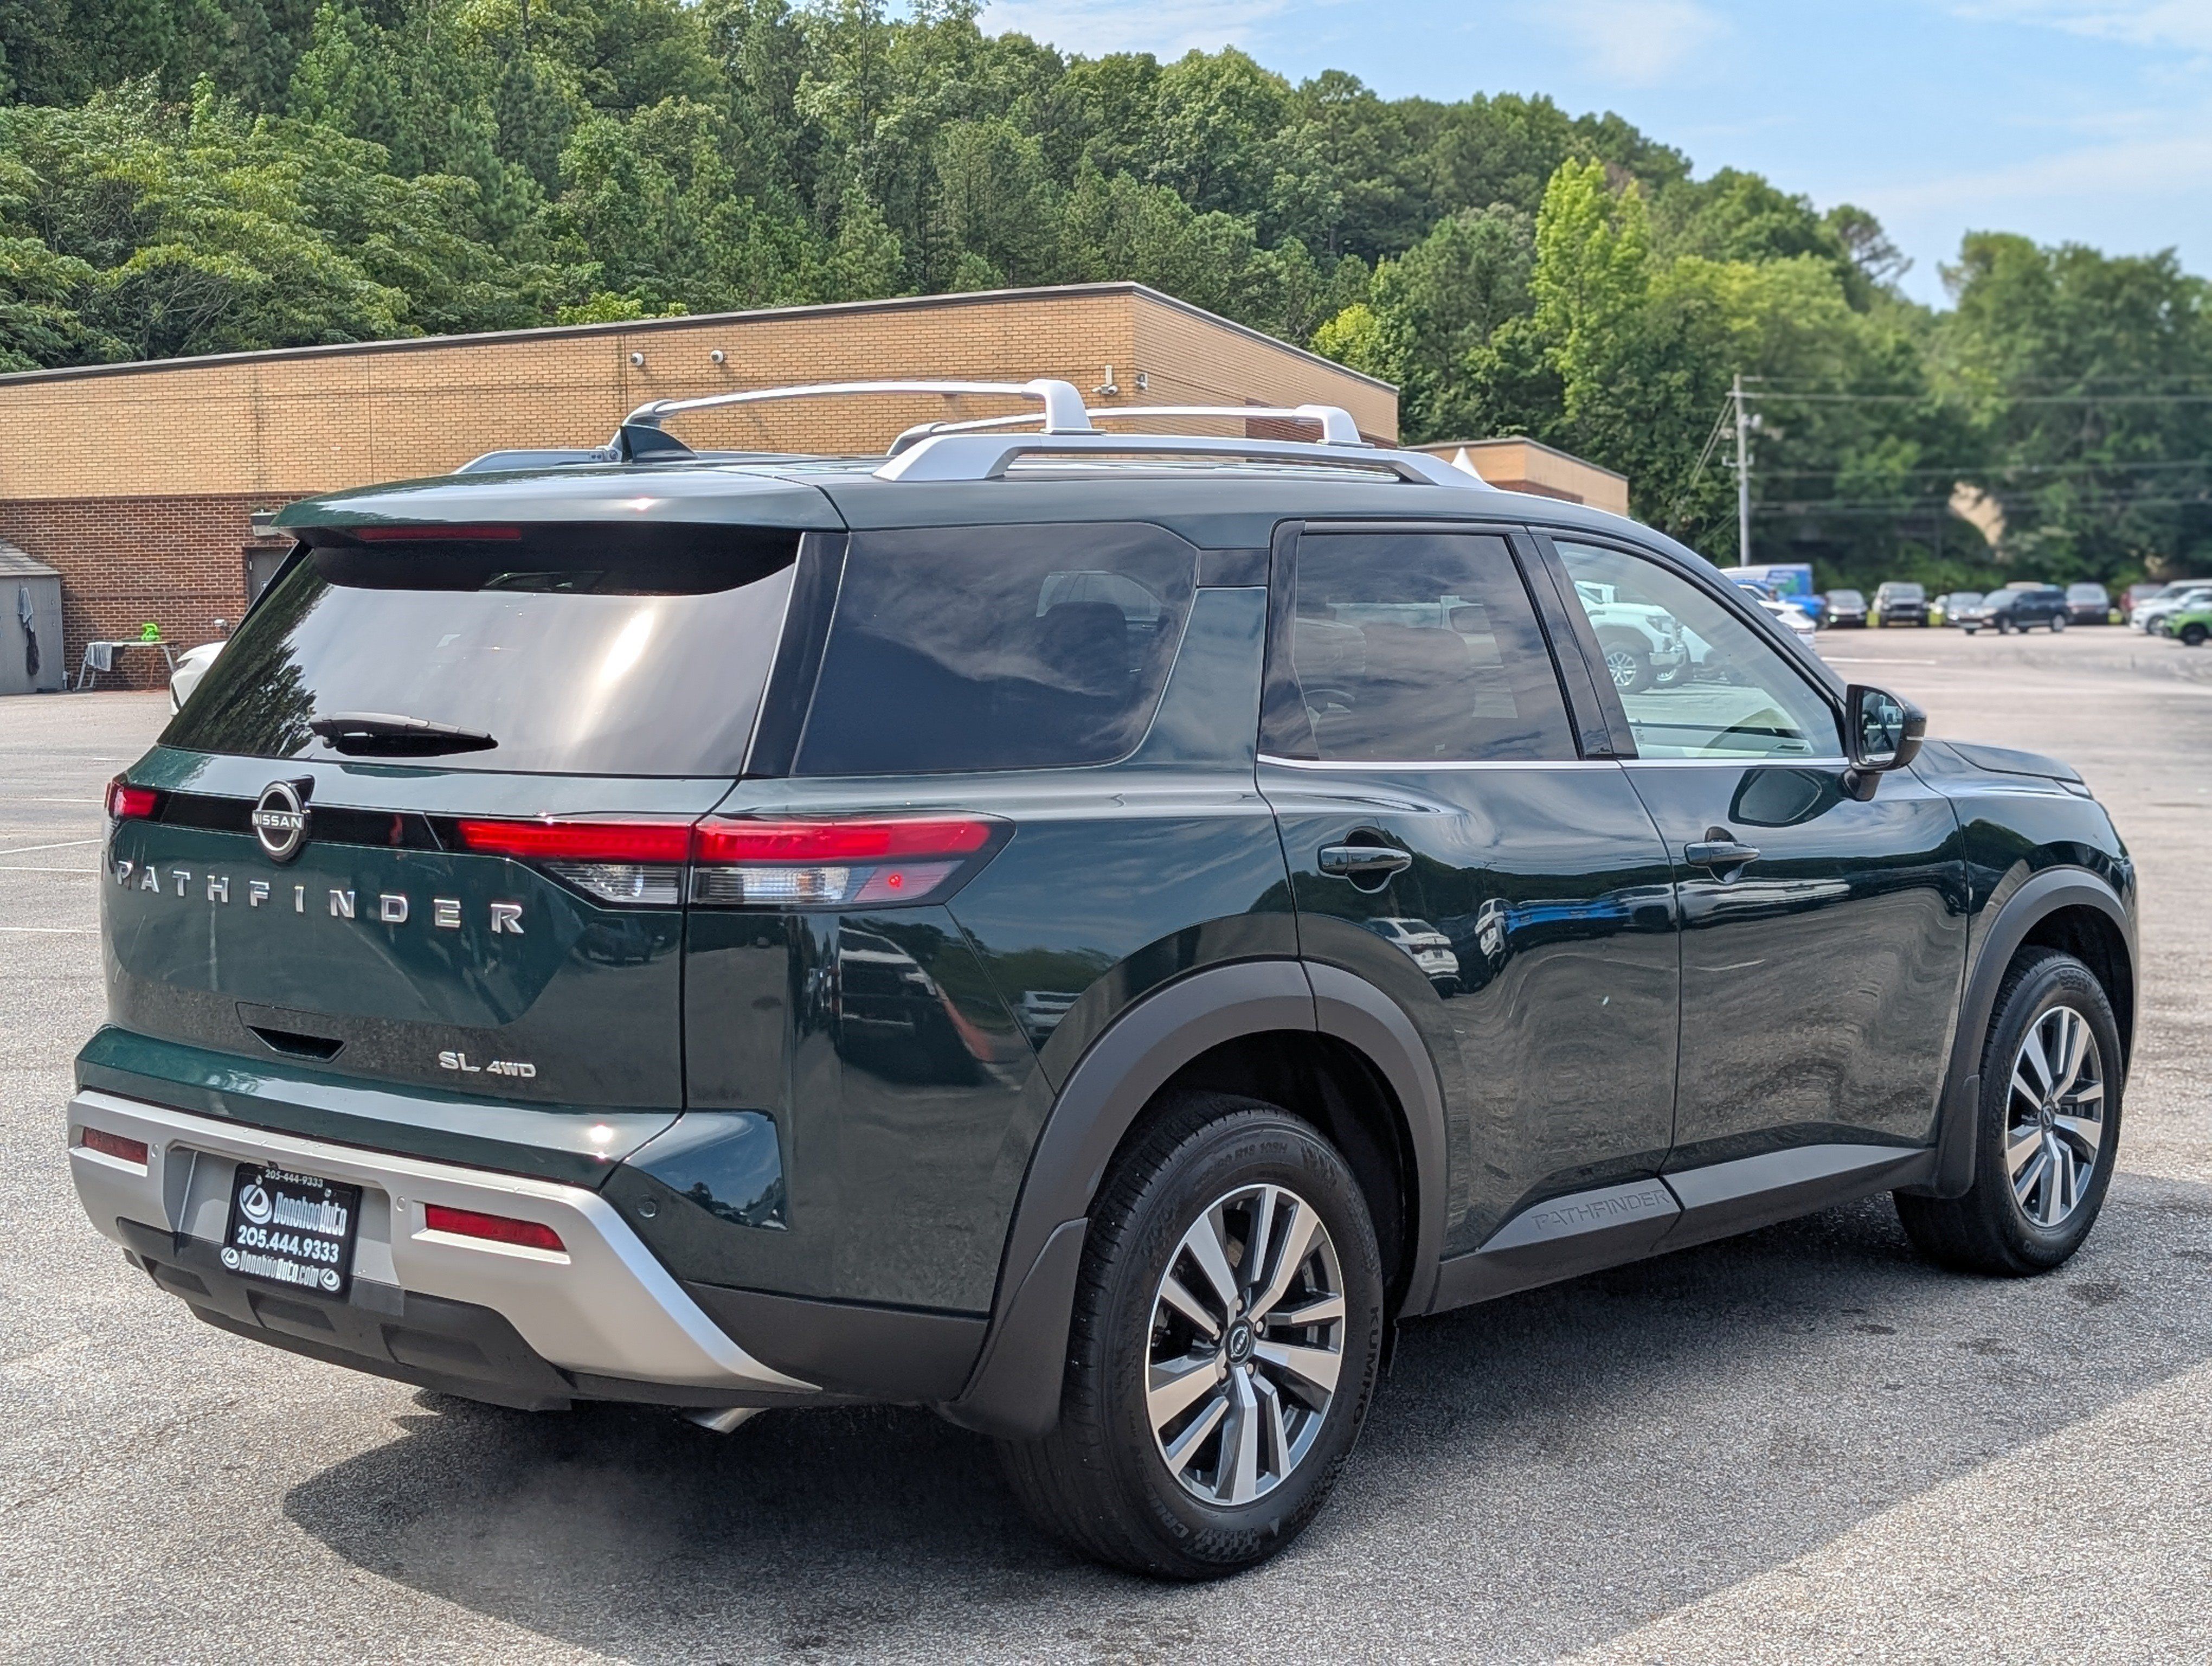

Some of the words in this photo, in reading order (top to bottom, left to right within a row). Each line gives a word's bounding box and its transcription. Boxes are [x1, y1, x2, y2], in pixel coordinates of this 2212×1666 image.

[252, 813, 303, 829] NISSAN
[116, 860, 524, 934] PATHFINDER
[438, 1051, 481, 1072] SL
[486, 1060, 536, 1078] 4WD
[265, 1169, 324, 1188] 205-444-9333
[273, 1192, 348, 1236] DonohooAuto
[1532, 1189, 1670, 1230] PATHFINDER
[236, 1225, 339, 1263] 205.444.9333
[1353, 1306, 1379, 1425] KUMHO
